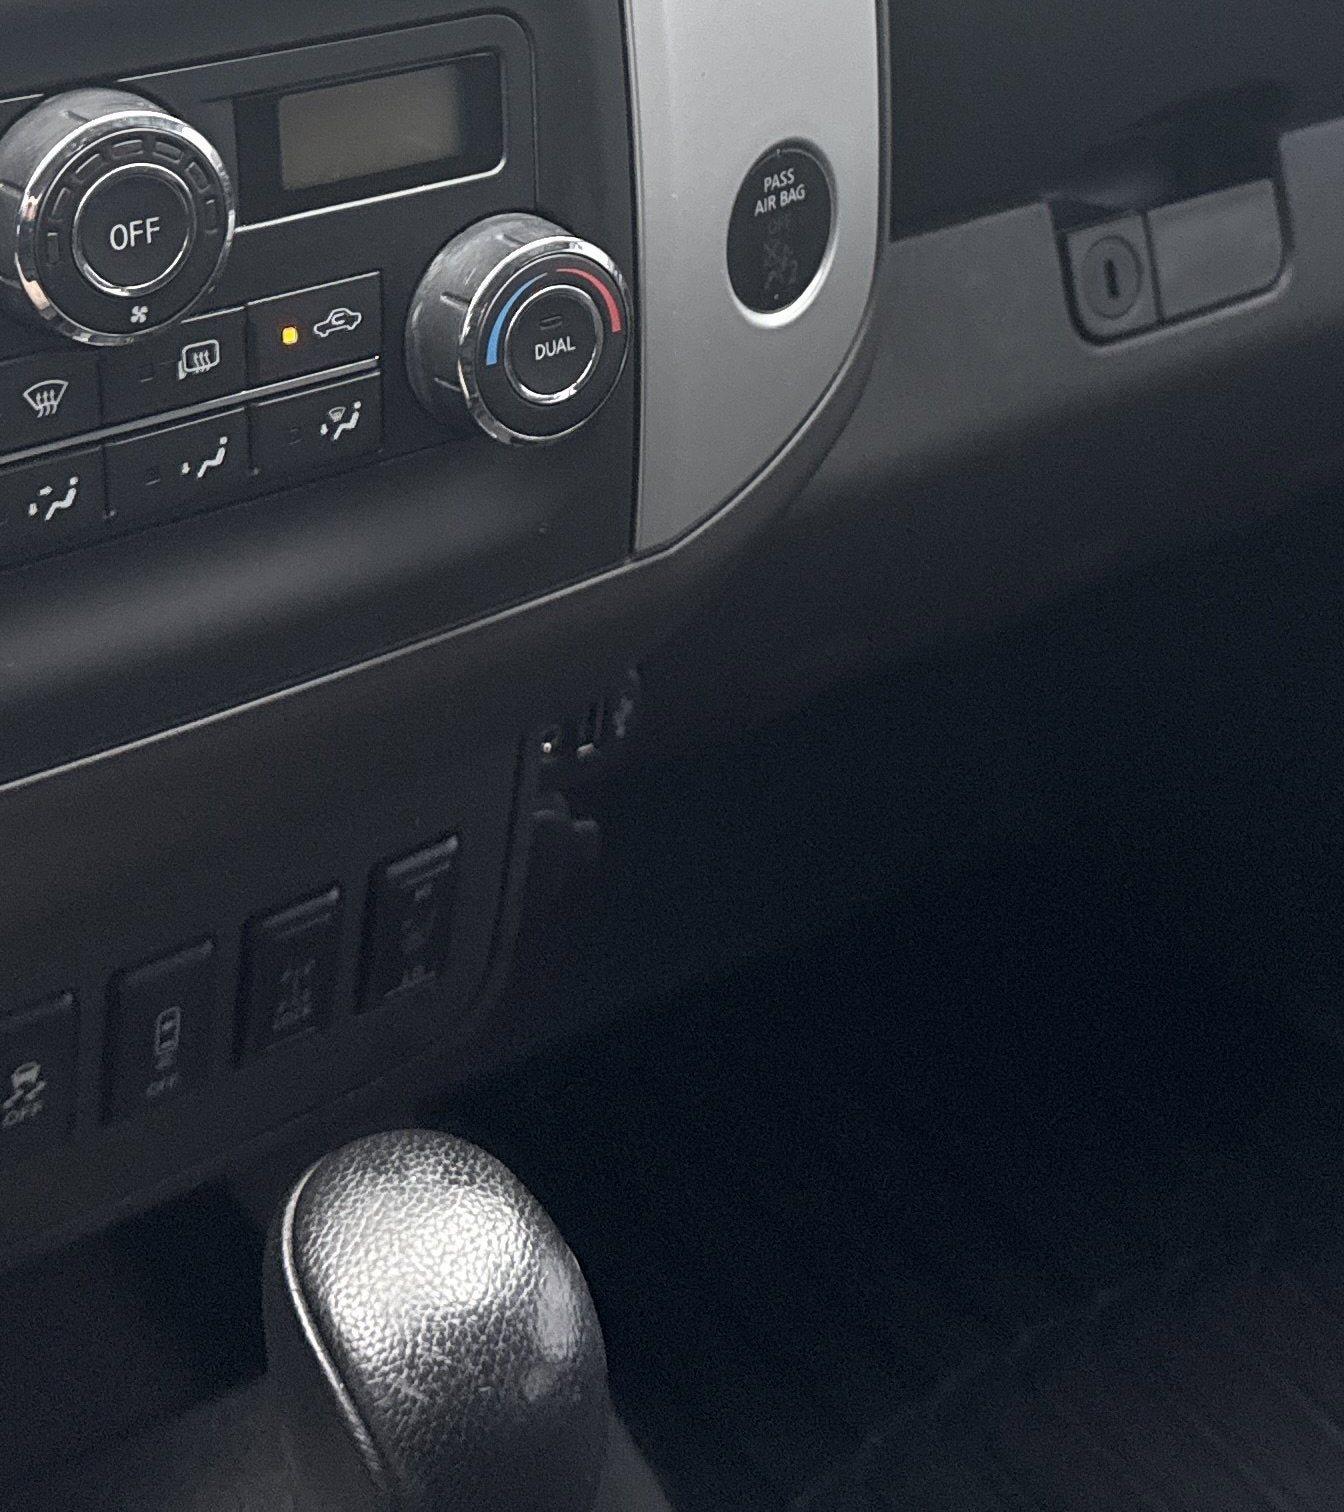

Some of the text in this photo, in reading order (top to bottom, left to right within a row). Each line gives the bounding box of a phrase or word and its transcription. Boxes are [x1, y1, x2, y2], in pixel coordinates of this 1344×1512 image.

[763, 167, 796, 193] PASS
[754, 183, 806, 217] AIR BAG
[109, 216, 161, 252] OFF
[534, 335, 577, 362] DUAL
[2, 1099, 45, 1129] OFF
